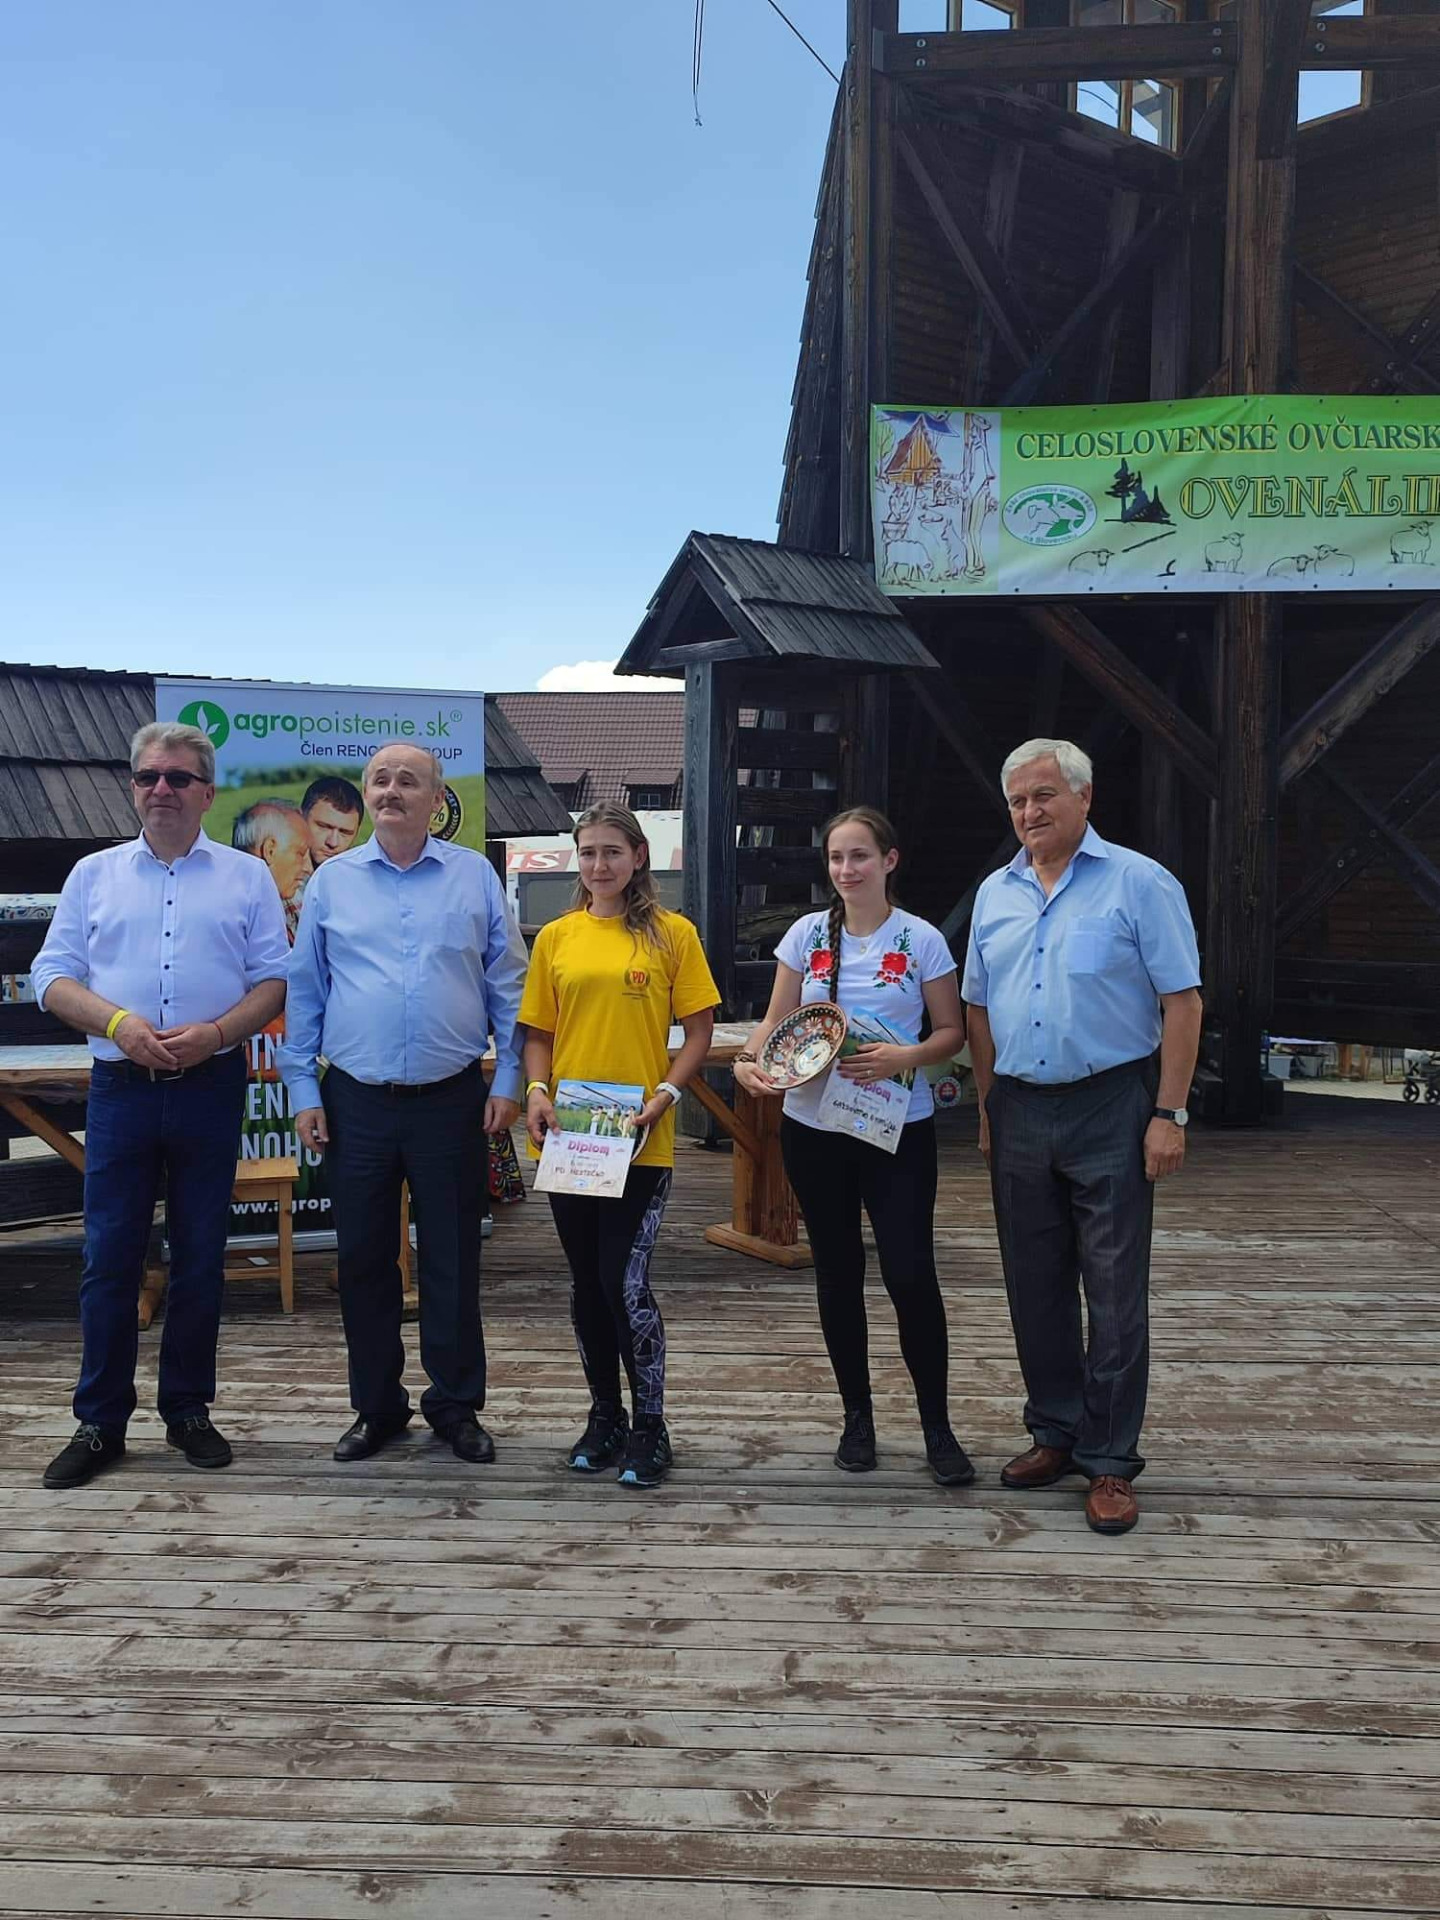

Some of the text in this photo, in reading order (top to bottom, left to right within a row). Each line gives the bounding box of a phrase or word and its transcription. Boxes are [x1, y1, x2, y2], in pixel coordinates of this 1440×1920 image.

[1016, 414, 1440, 460] CELOSLOVENSKÉ OVČIARSK
[300, 740, 333, 757] Člen
[568, 1141, 610, 1156] Diplom
